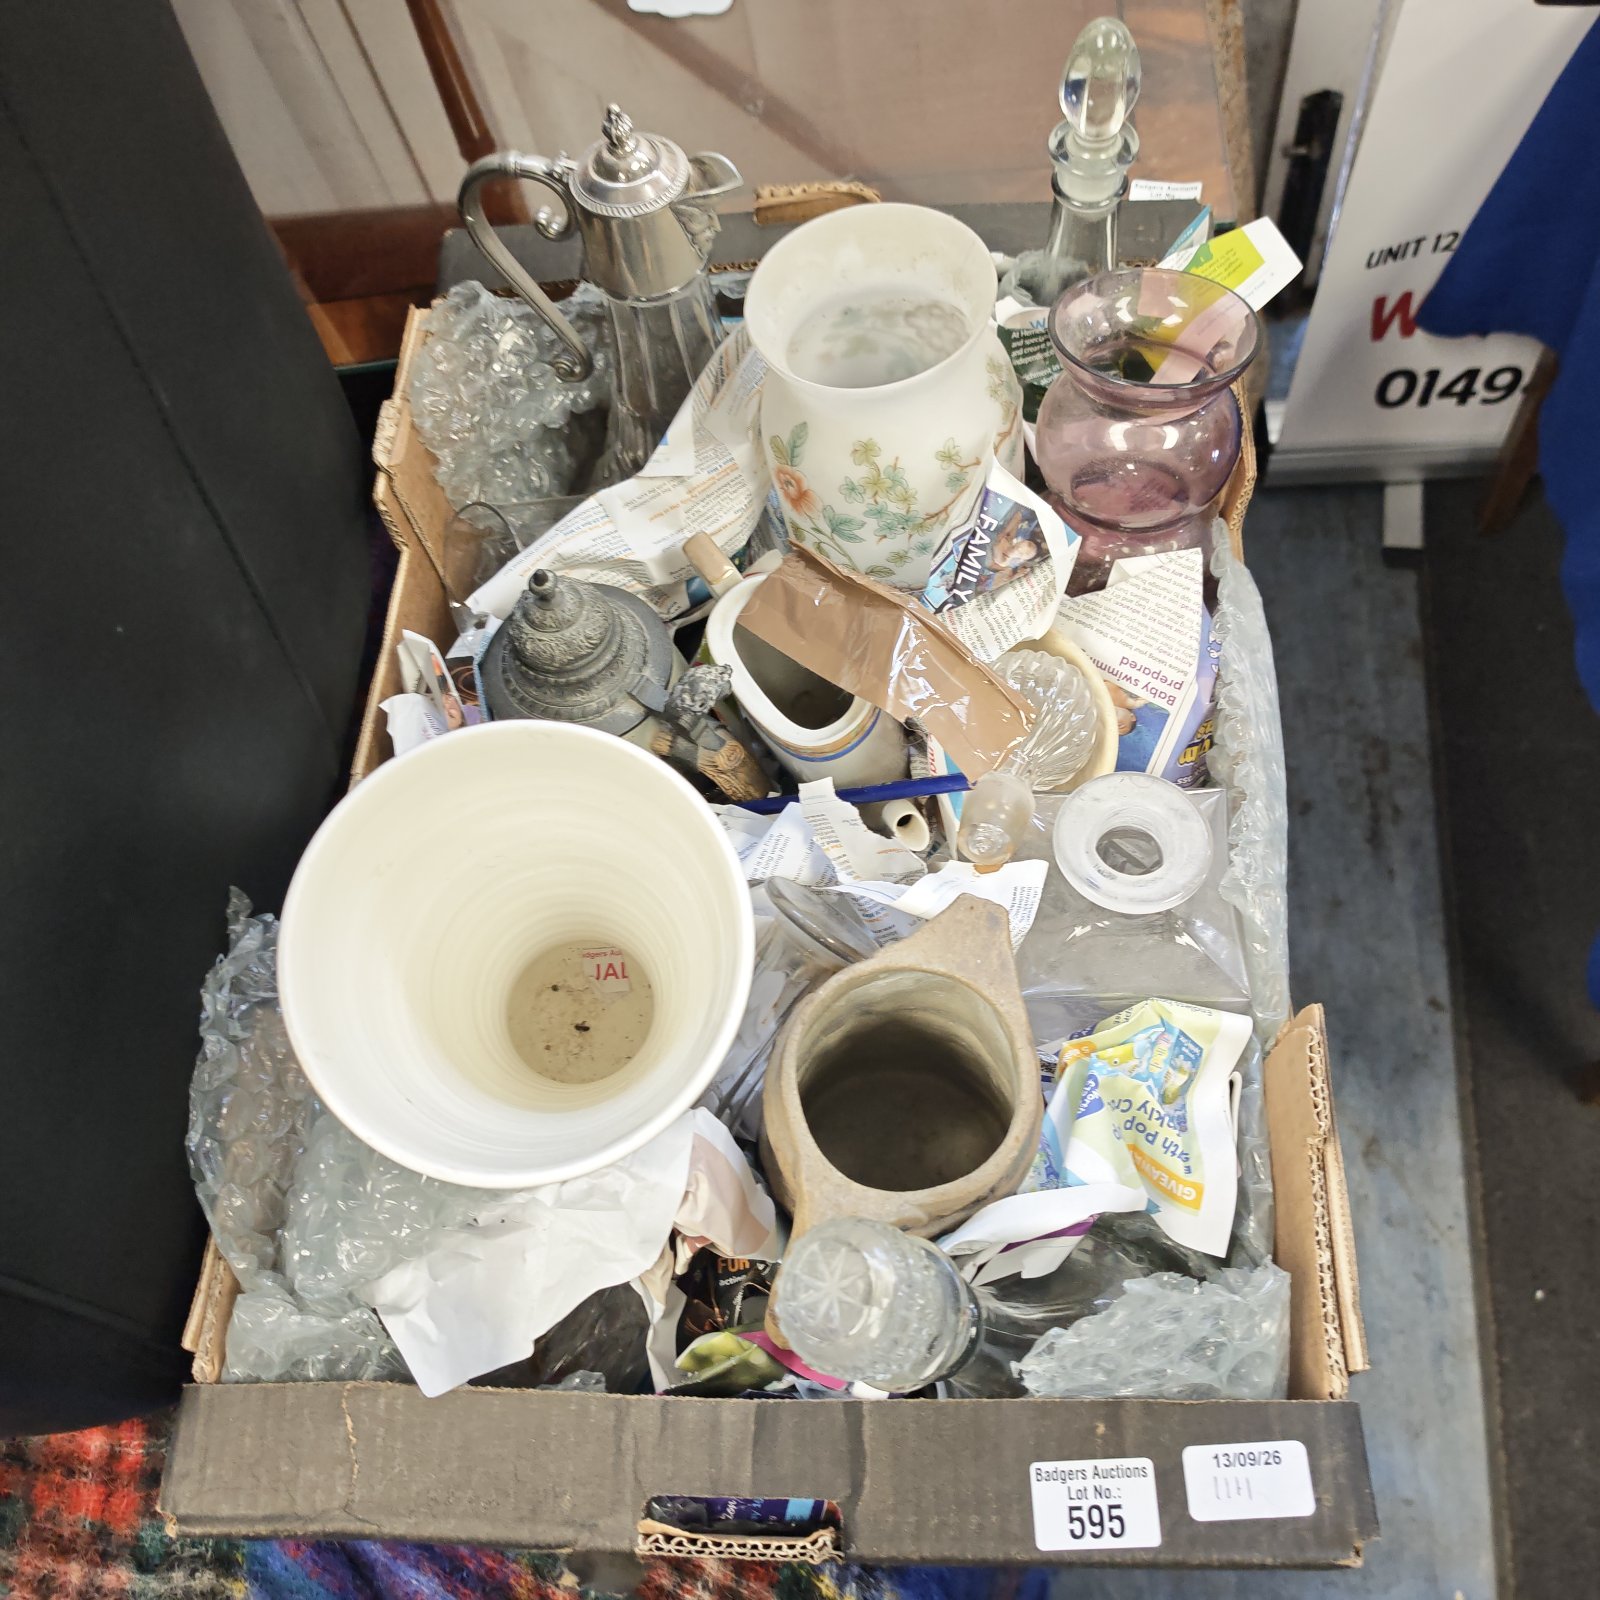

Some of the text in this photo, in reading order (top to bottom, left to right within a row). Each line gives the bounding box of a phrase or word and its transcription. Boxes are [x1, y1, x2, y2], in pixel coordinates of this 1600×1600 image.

[1366, 236, 1426, 269] UNIT
[1370, 289, 1424, 343] W
[1375, 365, 1526, 409] 0149
[953, 513, 998, 603] FAMILY
[1085, 650, 1176, 706] Baby swimmi
[1119, 656, 1184, 690] prepared
[1123, 1116, 1159, 1146] Pop
[1035, 1464, 1148, 1484] Badgers Auctions
[1212, 1450, 1282, 1469] 13/09/26
[1067, 1484, 1122, 1501] Lot No.:
[1067, 1503, 1125, 1540] 595
